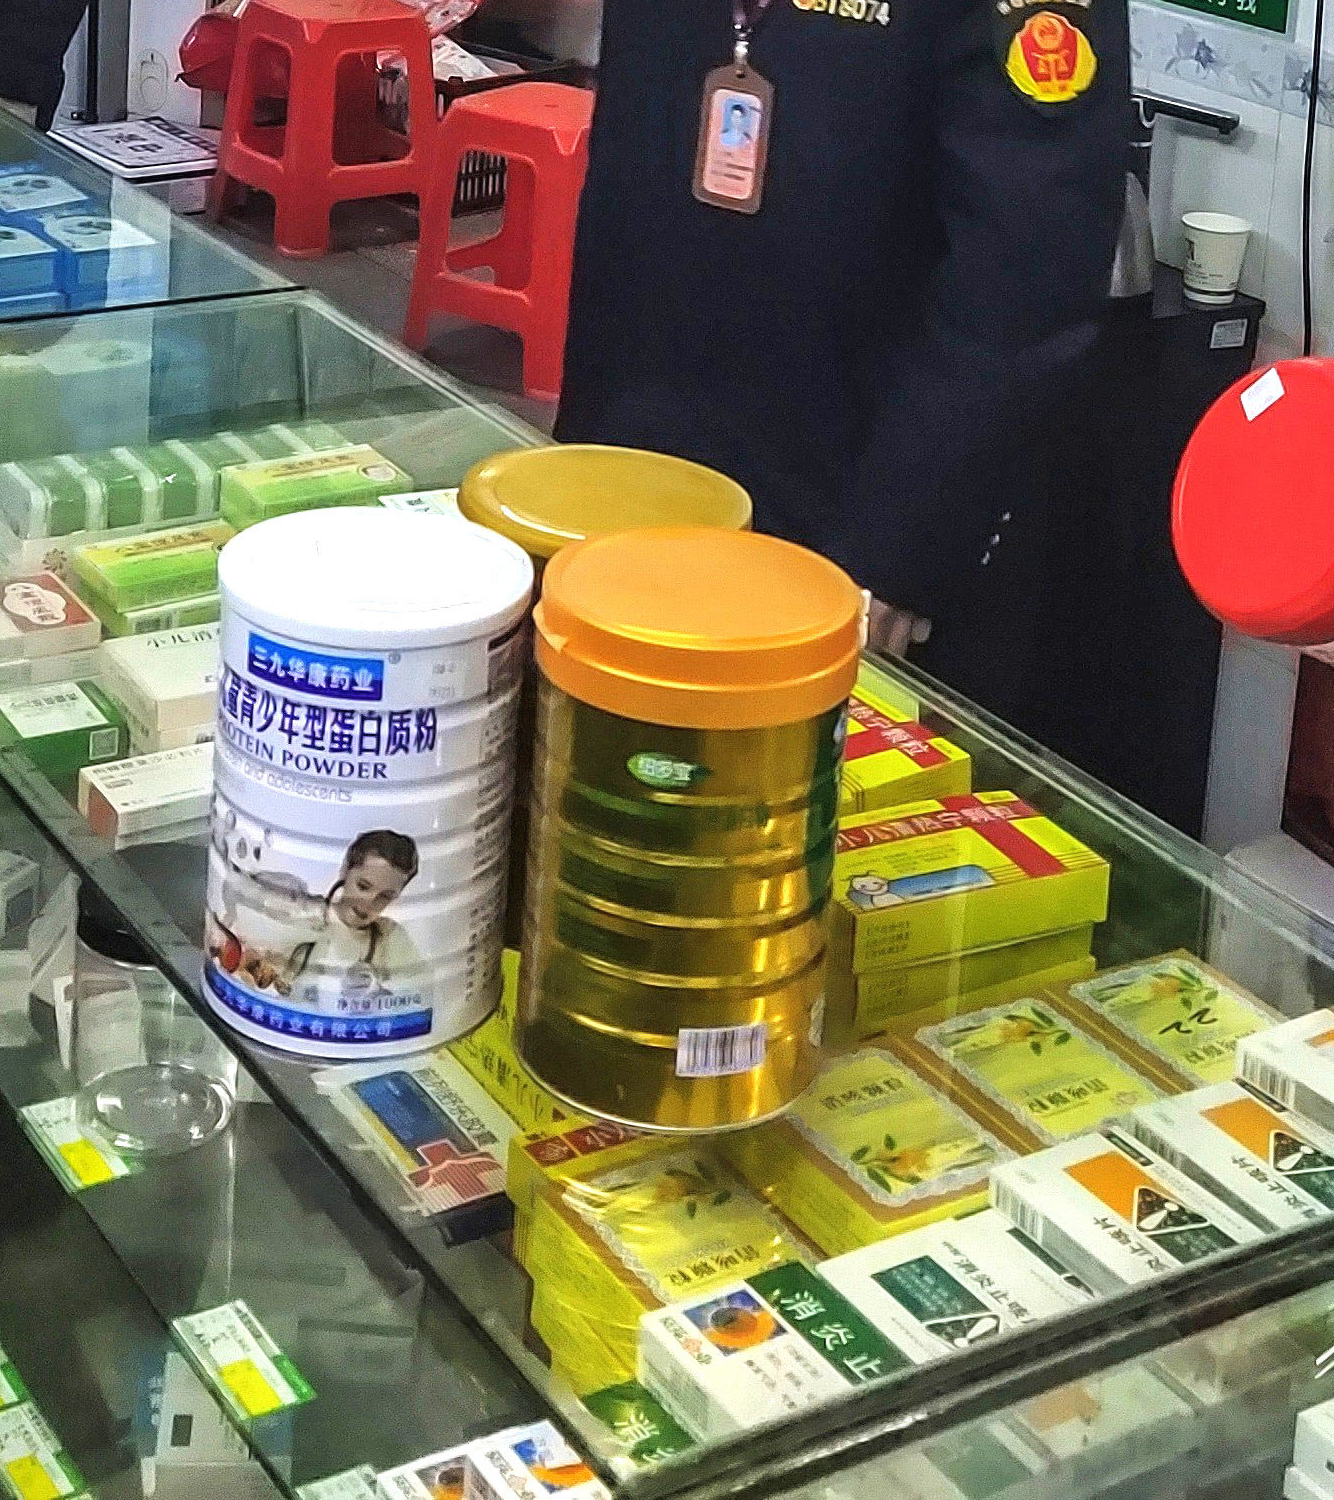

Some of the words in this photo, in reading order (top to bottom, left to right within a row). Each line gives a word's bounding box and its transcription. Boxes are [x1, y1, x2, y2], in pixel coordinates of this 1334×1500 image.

[253, 645, 374, 692] 三九华康药业
[282, 749, 388, 780] POWDER
